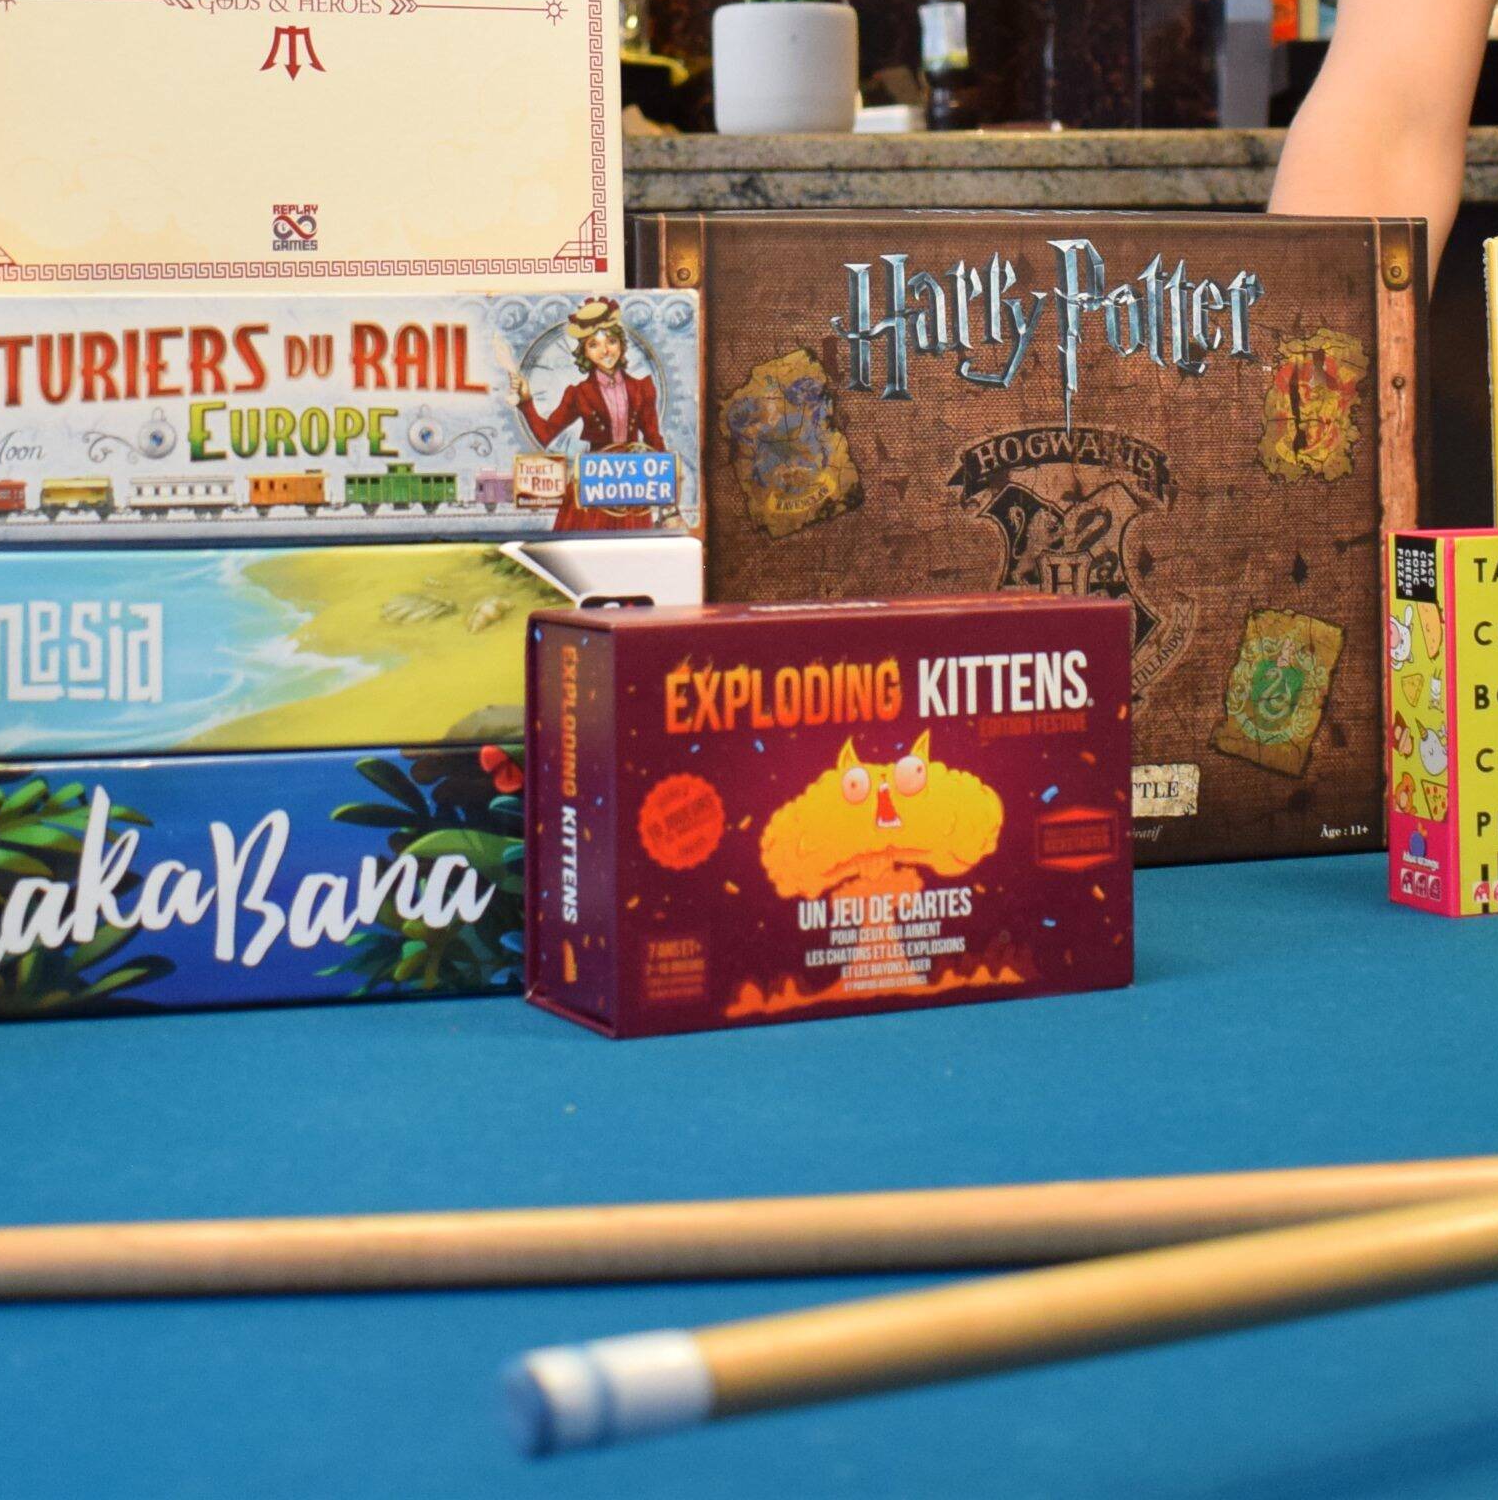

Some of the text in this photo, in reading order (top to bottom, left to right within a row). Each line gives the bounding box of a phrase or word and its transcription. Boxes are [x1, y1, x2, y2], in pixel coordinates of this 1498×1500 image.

[272, 204, 319, 215] REPLAY
[272, 239, 319, 252] GAMES
[829, 238, 1265, 437] Harry Potter
[283, 333, 334, 381] DU
[350, 320, 490, 395] RAIL
[188, 400, 400, 463] EUROPE
[584, 458, 671, 480] DAYS OF
[971, 430, 1156, 474] HOGWARTS
[531, 476, 561, 493] RIDE
[1397, 548, 1405, 587] PIZZA
[1404, 549, 1413, 597] CHEESE
[1412, 549, 1420, 586] BOUC
[1419, 550, 1428, 584] CHAT
[1427, 551, 1435, 588] TACO
[664, 649, 1089, 735] EXPLODING KITTENS
[561, 644, 578, 925] EXPLODING KITTENS
[1319, 823, 1342, 839] Âge
[1350, 824, 1369, 837] 11+
[797, 886, 973, 931] UN JEU DE CARTES
[804, 936, 966, 967] LES CHATONS ET LES EXPLOSIONS
[829, 929, 858, 946] POUR
[903, 920, 942, 938] AIMENT
